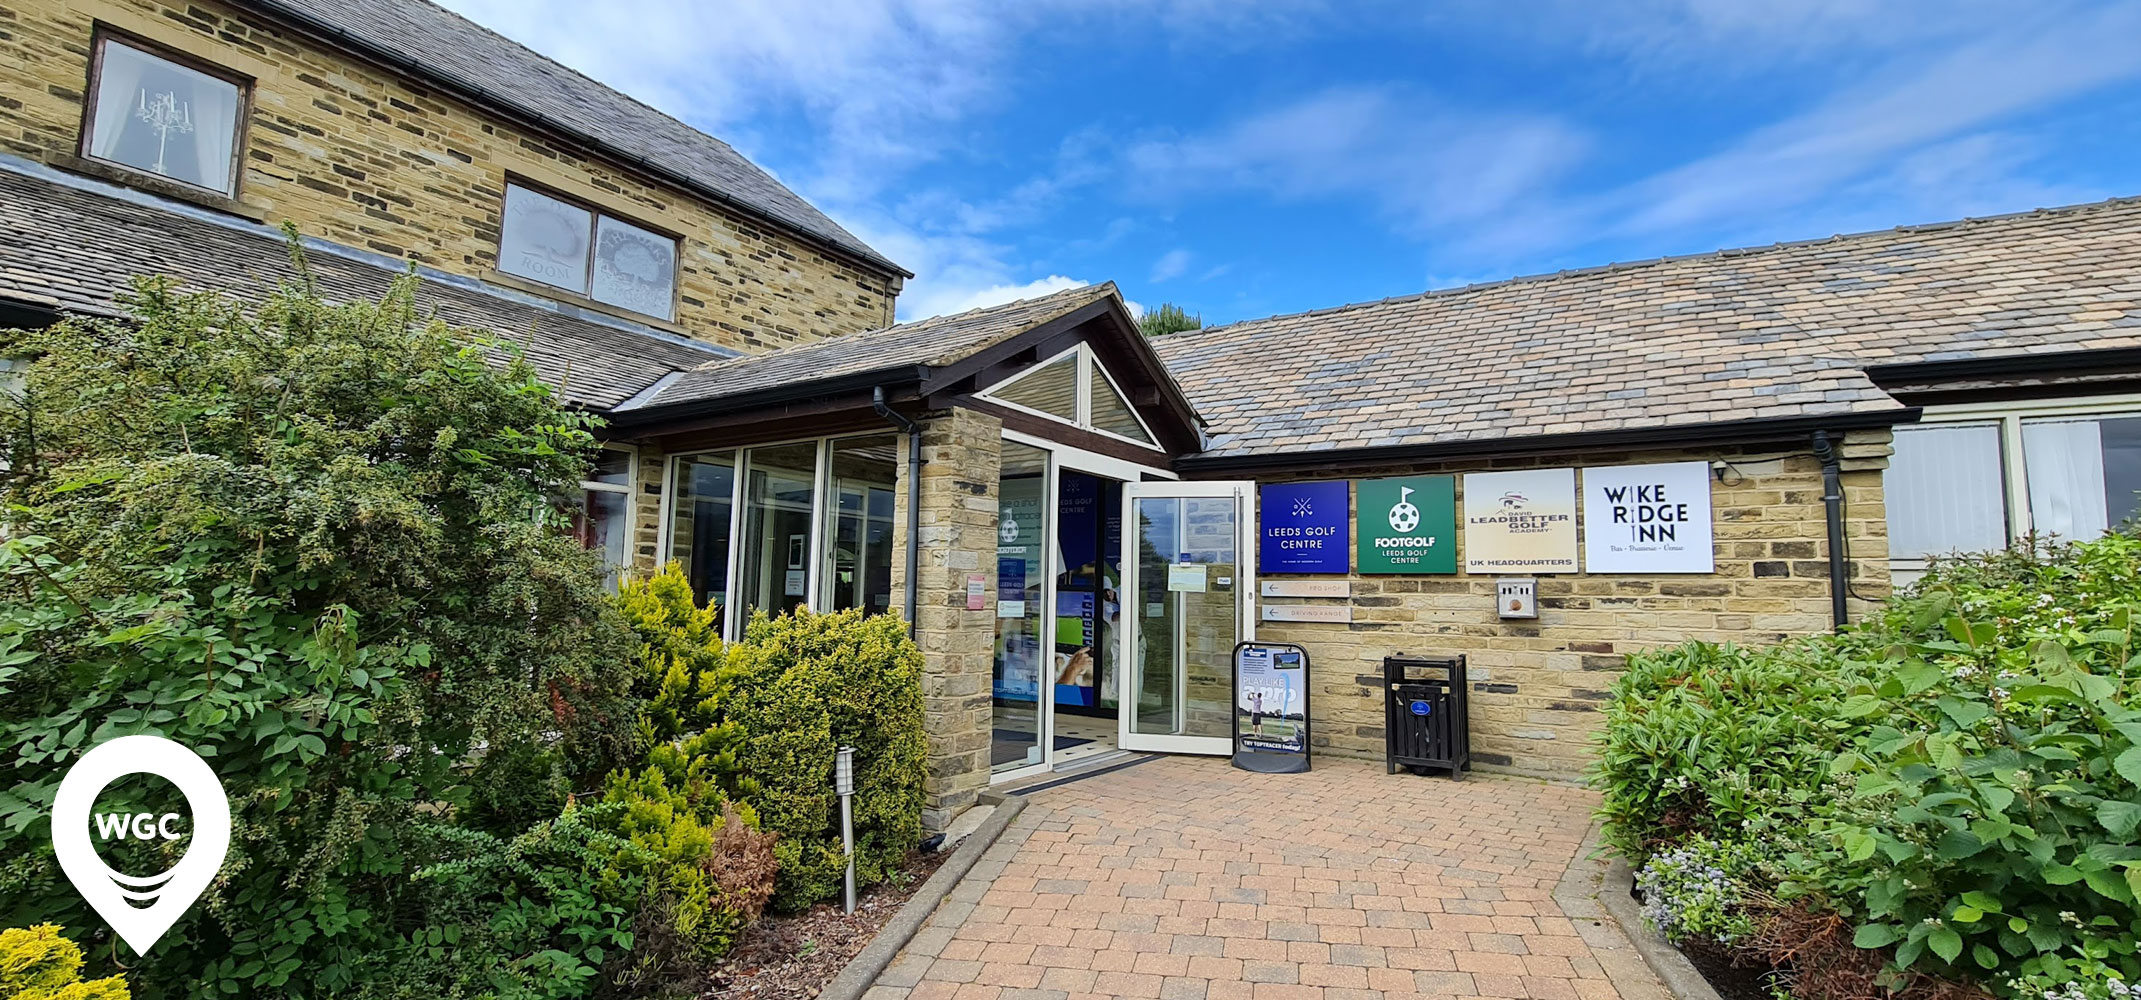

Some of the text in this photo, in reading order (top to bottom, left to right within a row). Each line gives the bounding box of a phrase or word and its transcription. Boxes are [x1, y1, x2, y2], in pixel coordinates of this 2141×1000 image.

[521, 257, 570, 279] ROOM
[1603, 485, 1666, 504] WIKE
[1470, 514, 1569, 524] LEADBETTER
[1613, 504, 1688, 523] RIDGE
[1268, 527, 1336, 537] LEEDS GOLF
[1631, 524, 1675, 542] INN
[1280, 540, 1323, 549] CENTRE
[1375, 537, 1435, 548] FOOTGOLF
[1243, 676, 1285, 687] PLAY LIKE
[1261, 686, 1297, 703] pro
[1254, 741, 1282, 749] TOPTRACER
